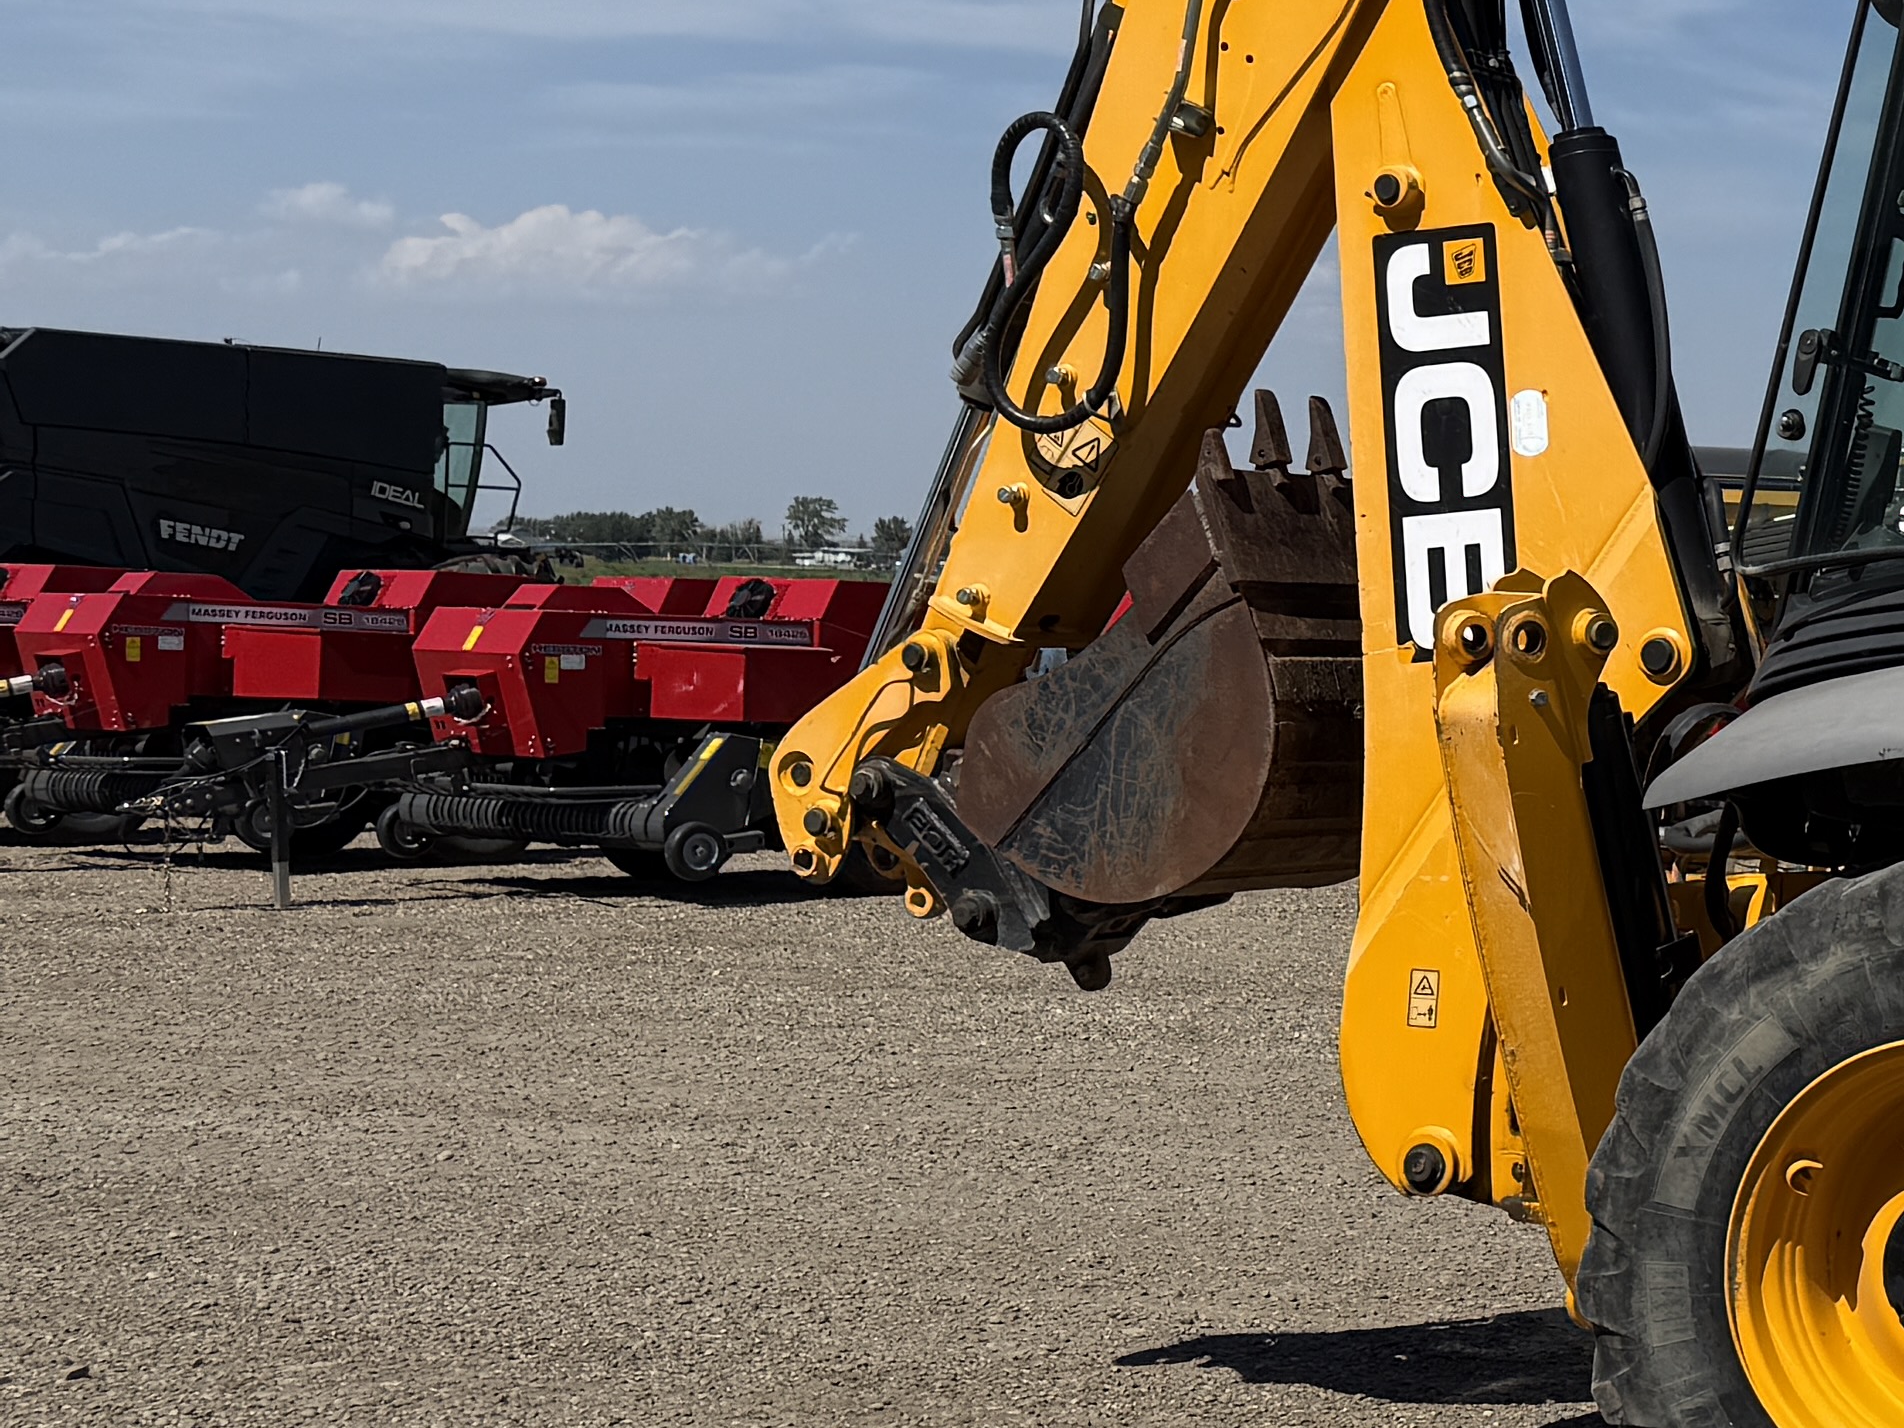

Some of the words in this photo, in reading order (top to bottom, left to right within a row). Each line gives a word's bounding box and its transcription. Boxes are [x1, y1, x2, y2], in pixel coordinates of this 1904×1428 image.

[1453, 249, 1475, 278] JCB
[370, 480, 425, 509] IDEAL
[159, 518, 245, 552] FENDT
[191, 607, 240, 619] MASSEY
[244, 609, 307, 622] FERGUSON
[323, 611, 354, 626] SB
[654, 624, 714, 637] FERGUSON
[728, 625, 758, 639] SB
[1673, 1054, 1765, 1178] XMCL
